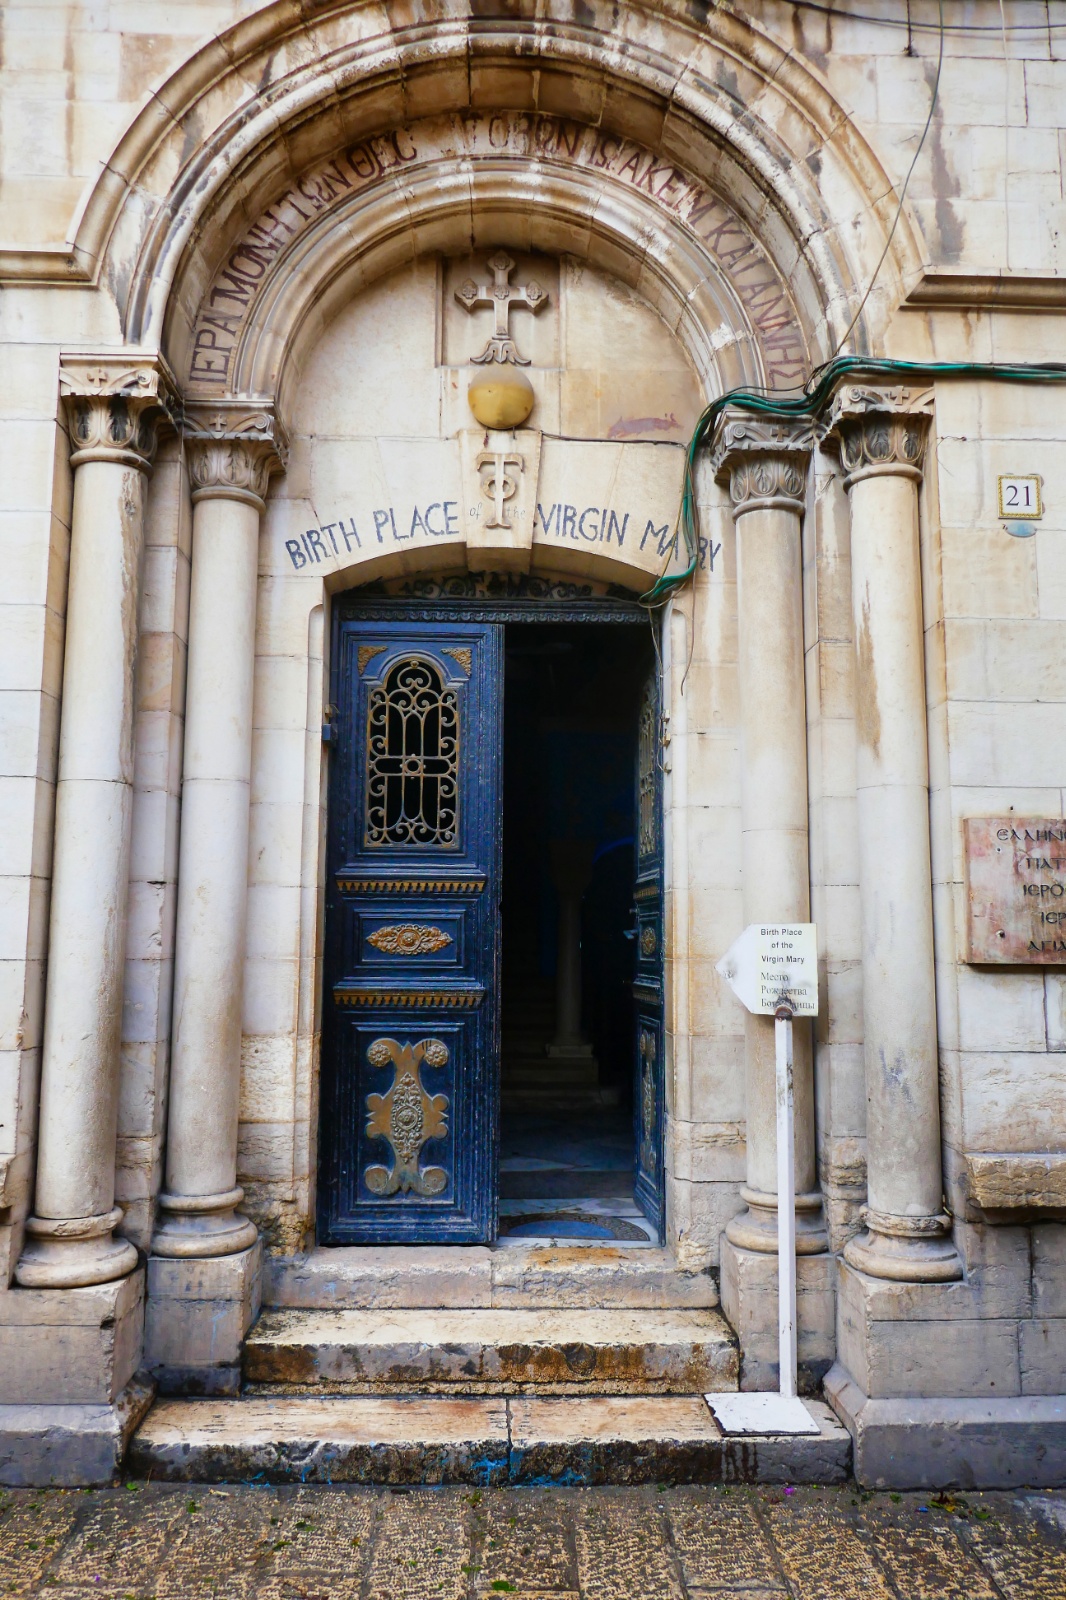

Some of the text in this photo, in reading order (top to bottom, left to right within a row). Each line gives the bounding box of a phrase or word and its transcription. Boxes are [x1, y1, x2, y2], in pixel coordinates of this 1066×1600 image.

[702, 216, 766, 277] ΚΑΙ
[1005, 484, 1032, 507] 21
[285, 517, 362, 570] BIRTH
[372, 501, 460, 544] PLACE
[469, 502, 483, 520] of
[537, 503, 630, 547] VIRGIN
[639, 519, 722, 573] MARY
[760, 928, 803, 936] Birth Place
[771, 941, 793, 949] of the
[761, 955, 805, 964] Virgin Mary
